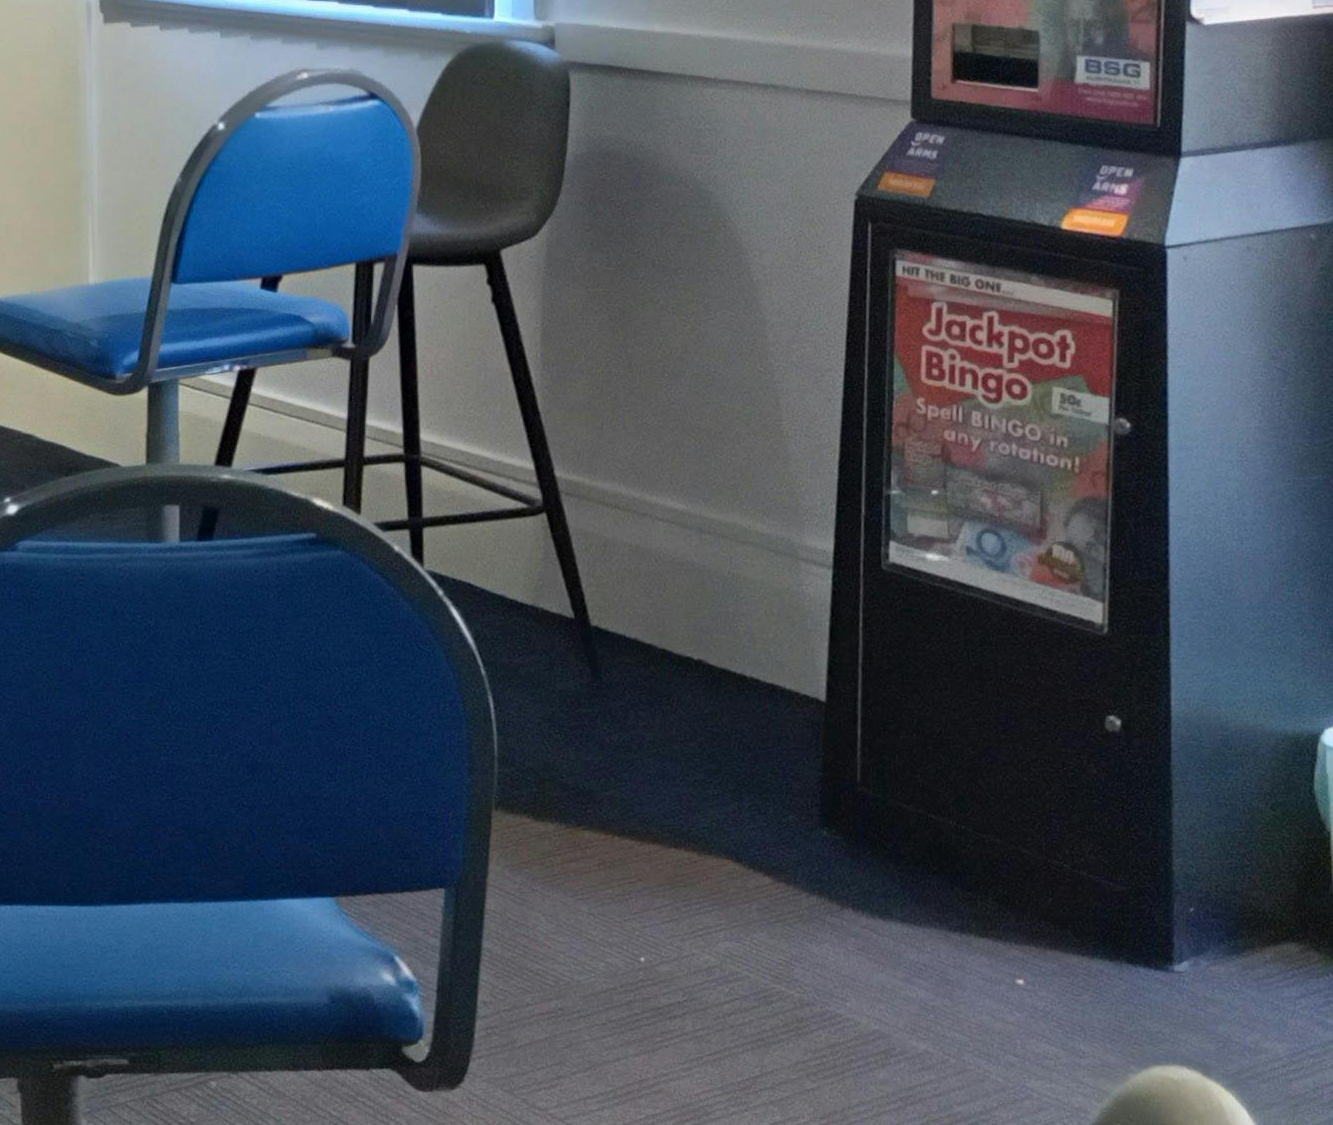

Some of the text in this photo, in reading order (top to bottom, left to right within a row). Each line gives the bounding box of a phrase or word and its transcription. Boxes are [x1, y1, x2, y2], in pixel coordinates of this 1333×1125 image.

[1084, 58, 1142, 79] BSG
[914, 131, 946, 145] OPEN
[906, 147, 938, 160] ARMS
[1099, 164, 1134, 178] OPEN
[1092, 181, 1129, 195] ARMS
[902, 265, 921, 278] HIT
[924, 269, 946, 282] THE
[949, 273, 971, 287] BIG
[923, 302, 1075, 369] Jackpot
[921, 345, 1032, 408] Bingo
[916, 397, 1069, 449] Spell BINGO in
[943, 428, 1081, 473] any rotation!
